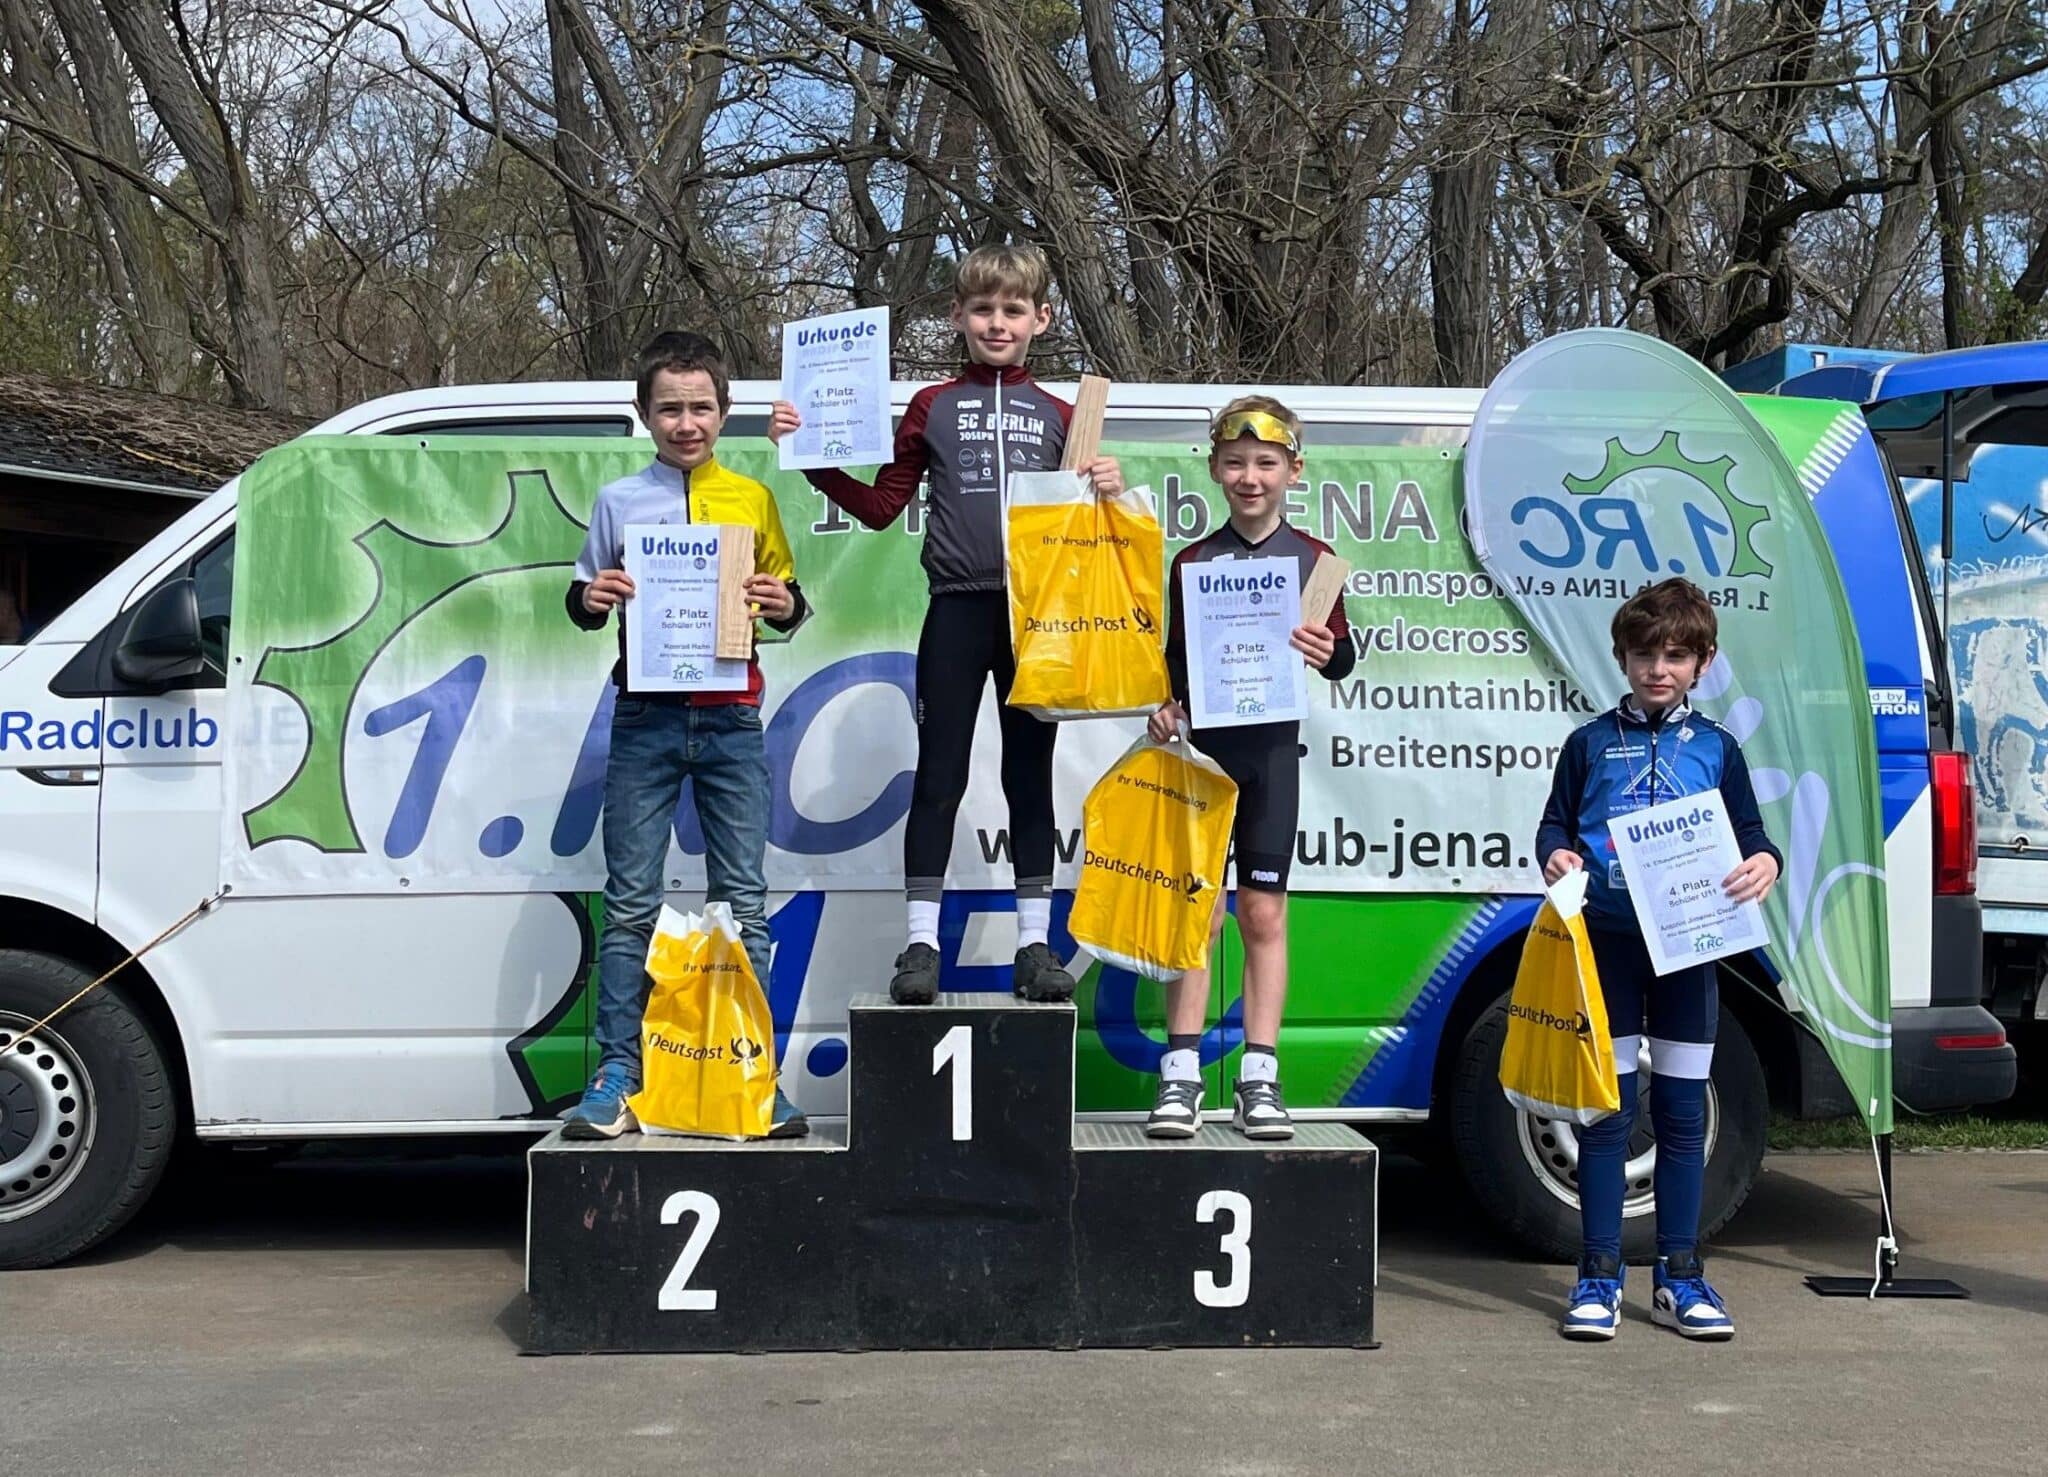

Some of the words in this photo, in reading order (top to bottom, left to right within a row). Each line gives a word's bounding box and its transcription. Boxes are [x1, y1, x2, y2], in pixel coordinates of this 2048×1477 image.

[798, 321, 878, 347] Urkunde
[814, 389, 824, 398] 1.
[827, 386, 854, 397] Platz
[810, 401, 840, 409] Schüler
[842, 399, 857, 407] U11
[957, 413, 979, 430] SC
[960, 431, 994, 441] JOSEPH
[1007, 432, 1042, 446] ATELIER
[1286, 483, 1437, 538] ENA
[642, 537, 718, 556] Urkund
[1199, 571, 1287, 593] Urkunde
[664, 609, 676, 618] 2.
[679, 608, 709, 618] Platz
[661, 621, 694, 629] Schüler
[696, 621, 712, 629] U11
[1025, 616, 1089, 632] Deutsch
[1094, 616, 1128, 631] Post
[1351, 619, 1529, 658] yclocross
[1223, 644, 1235, 655] 3.
[1237, 643, 1265, 653] Platz
[1220, 656, 1251, 665] Schüler
[1254, 655, 1269, 663] U11
[1872, 704, 1920, 715] TRON
[0, 708, 218, 750] Radclub
[1331, 735, 1565, 777] Breitenspor
[1116, 774, 1131, 785] Ihr
[1627, 808, 1715, 843] Urkunde
[1084, 850, 1151, 882] Deutsche
[1152, 870, 1180, 892] Post
[1669, 886, 1680, 897] 4.
[1682, 879, 1711, 892] Platz
[1668, 894, 1700, 908] Schüler
[1701, 889, 1717, 900] U11
[1510, 1004, 1549, 1027] eutsch
[932, 1025, 973, 1142] 1
[657, 1190, 722, 1312] 2
[1193, 1190, 1252, 1308] 3
